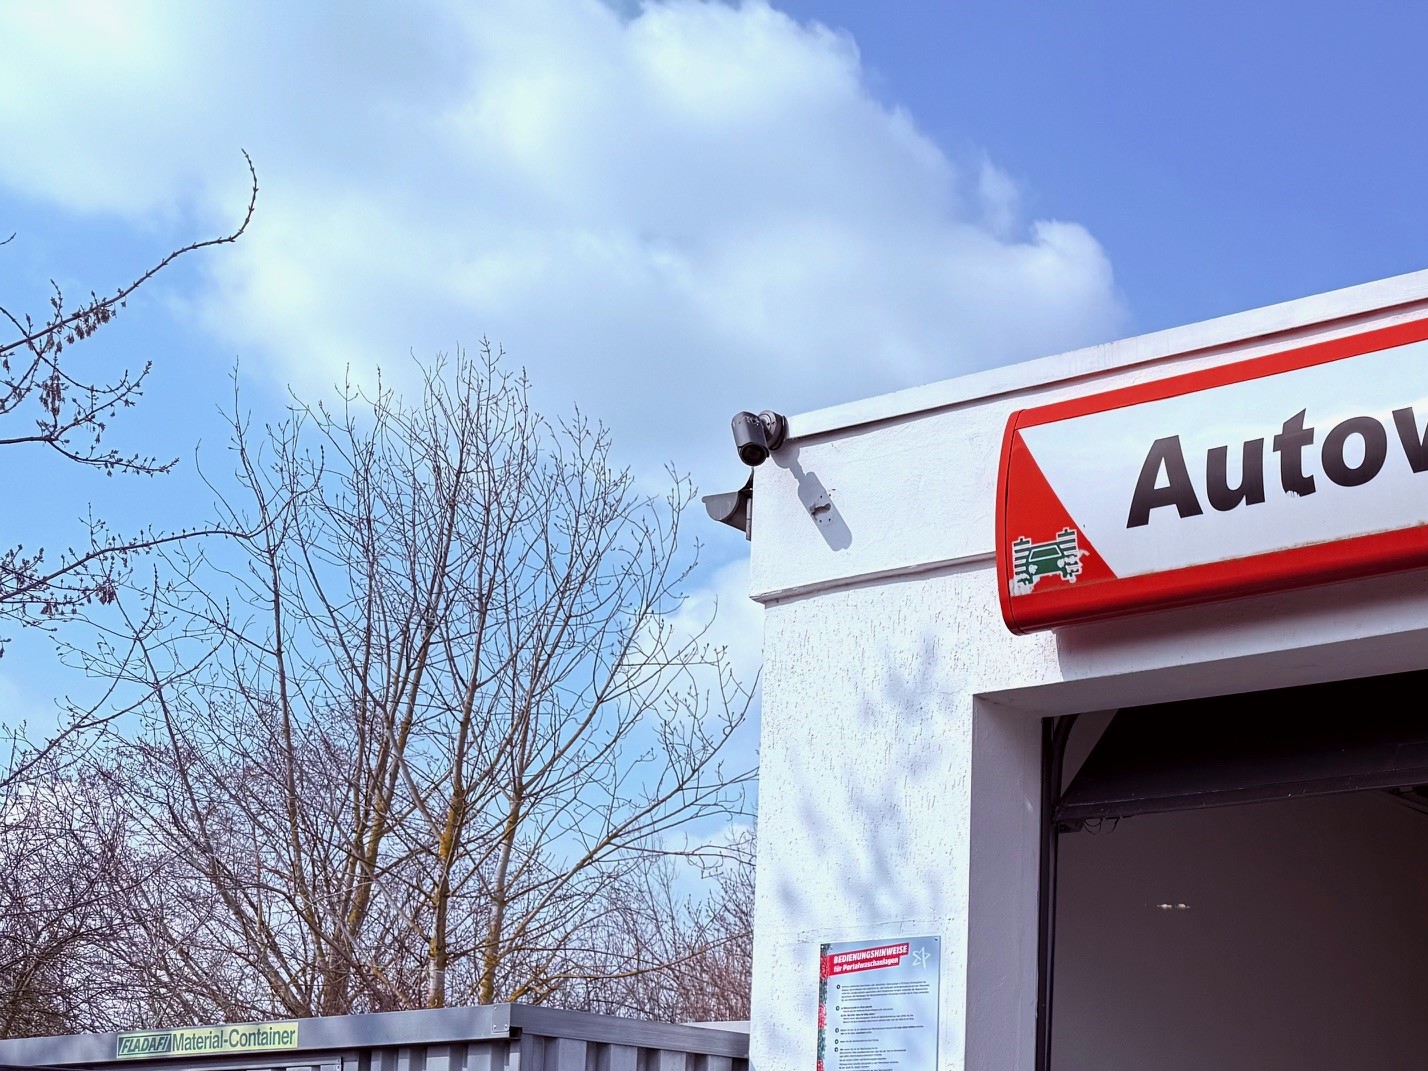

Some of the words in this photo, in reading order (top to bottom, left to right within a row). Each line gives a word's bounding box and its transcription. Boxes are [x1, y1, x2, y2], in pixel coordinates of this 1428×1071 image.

[833, 945, 908, 964] BEDIENUNGSHINWEISE
[833, 965, 843, 973] für
[843, 957, 899, 971] Portalwaschanlagen
[120, 1035, 170, 1053] FLADAFI
[172, 1027, 296, 1051] Material-Container
